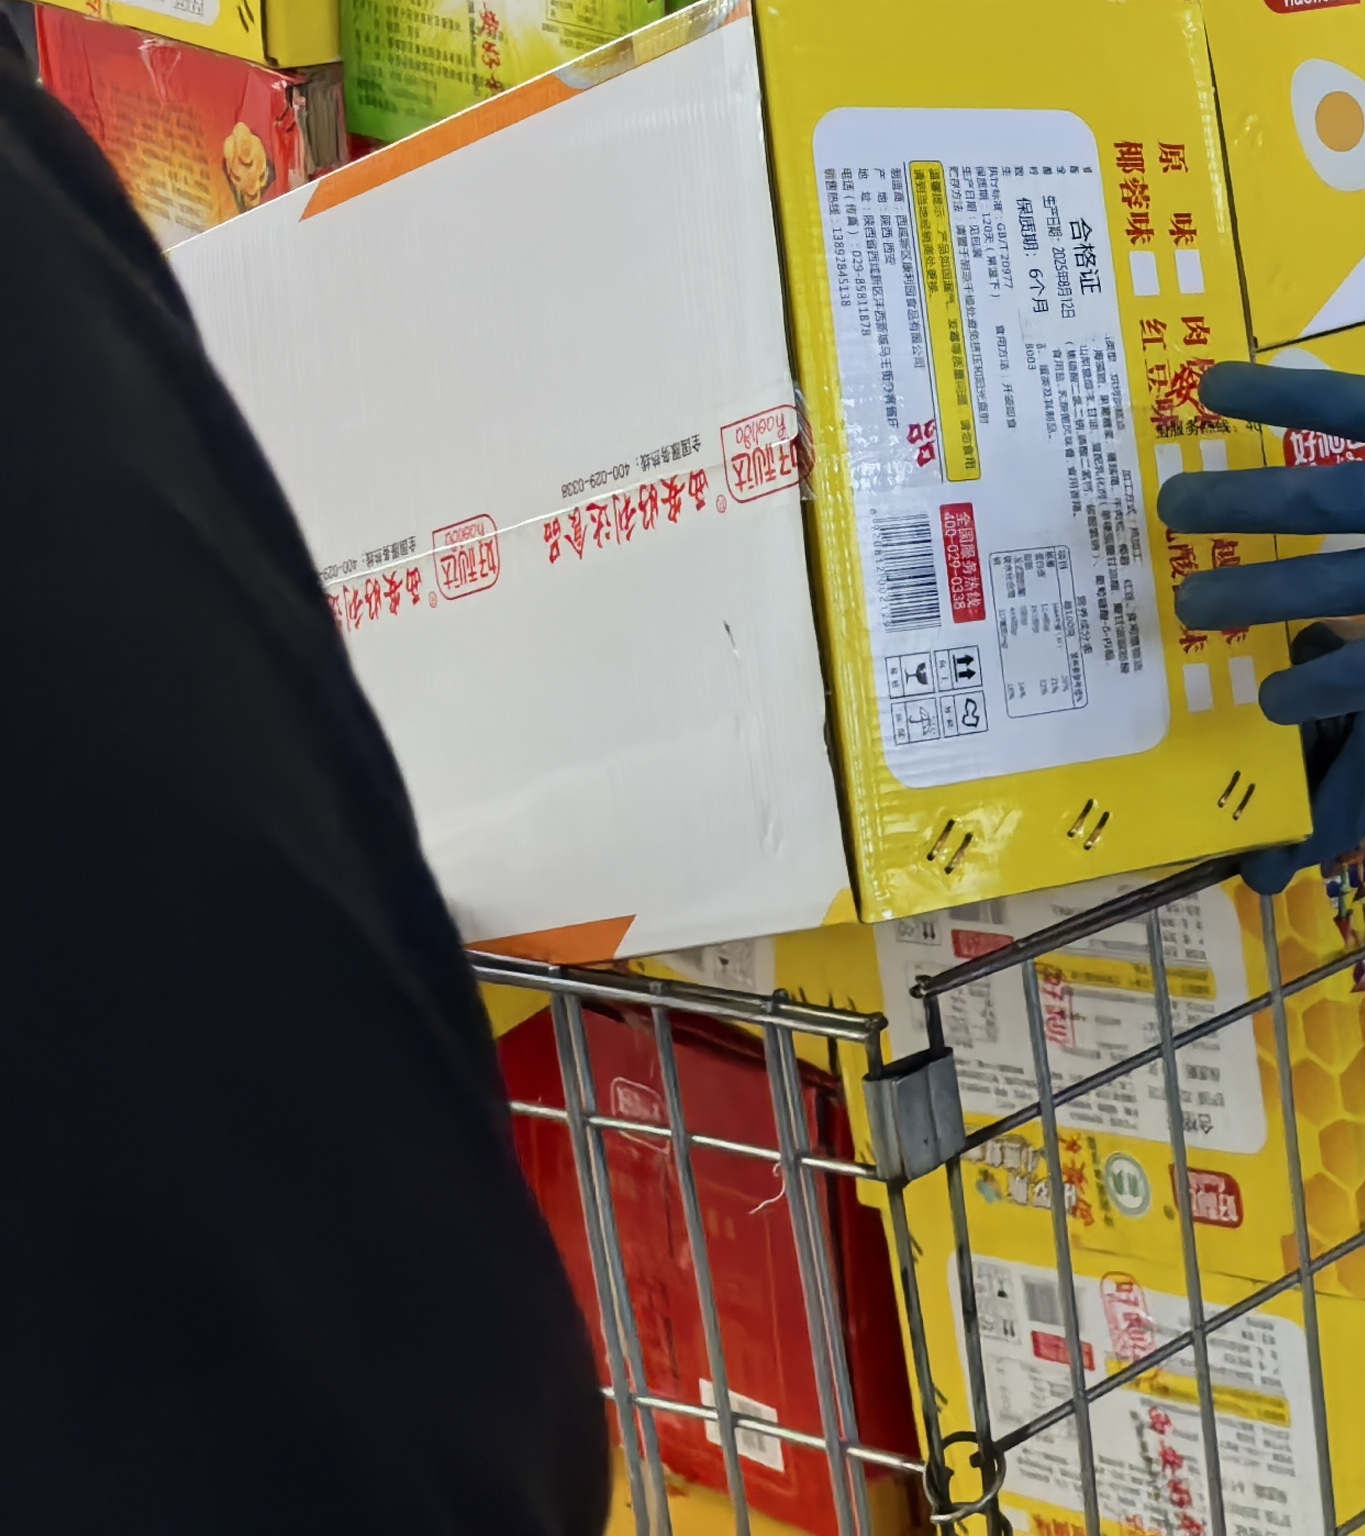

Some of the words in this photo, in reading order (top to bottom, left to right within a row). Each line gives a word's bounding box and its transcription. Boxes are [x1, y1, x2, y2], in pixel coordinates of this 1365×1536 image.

[1015, 197, 1039, 258] 保质期:
[1041, 194, 1064, 242] 生产日期:
[1113, 139, 1156, 247] 椰蓉味
[1156, 139, 1198, 247] 原味
[1026, 267, 1049, 314] 6个月
[1067, 216, 1102, 296] 合格证
[560, 462, 632, 499] 400-029-0338
[541, 467, 710, 566] 西安好利达食品
[438, 540, 499, 591] 好利达
[942, 511, 964, 610] 400-029-0338
